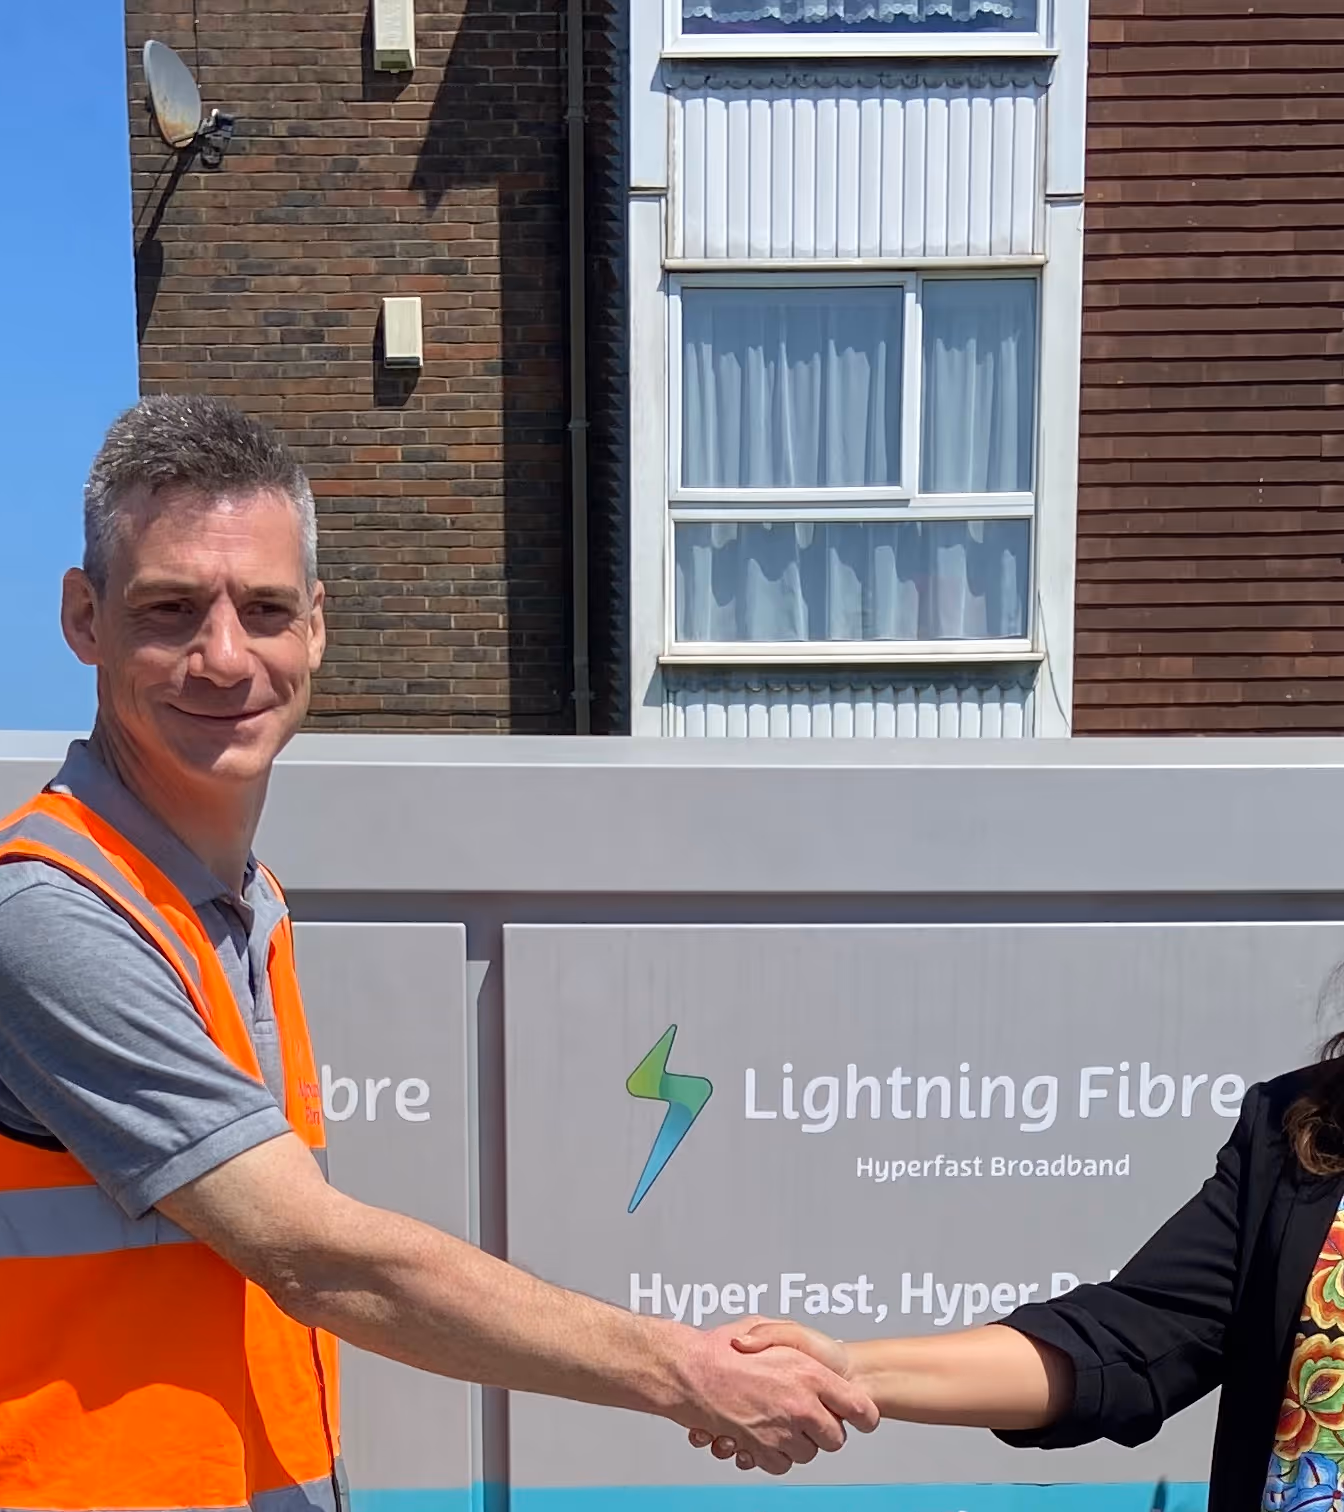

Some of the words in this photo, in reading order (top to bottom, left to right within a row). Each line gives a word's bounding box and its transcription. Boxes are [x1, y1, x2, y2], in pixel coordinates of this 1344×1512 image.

[321, 1064, 430, 1121] bre
[744, 1062, 1059, 1133] Lightning
[1078, 1061, 1246, 1119] Fibre
[856, 1154, 984, 1182] Hyperfast
[990, 1153, 1130, 1177] Broadband
[629, 1272, 769, 1327] Hyper
[779, 1272, 888, 1324] Fast,
[900, 1272, 1040, 1326] Hyper
